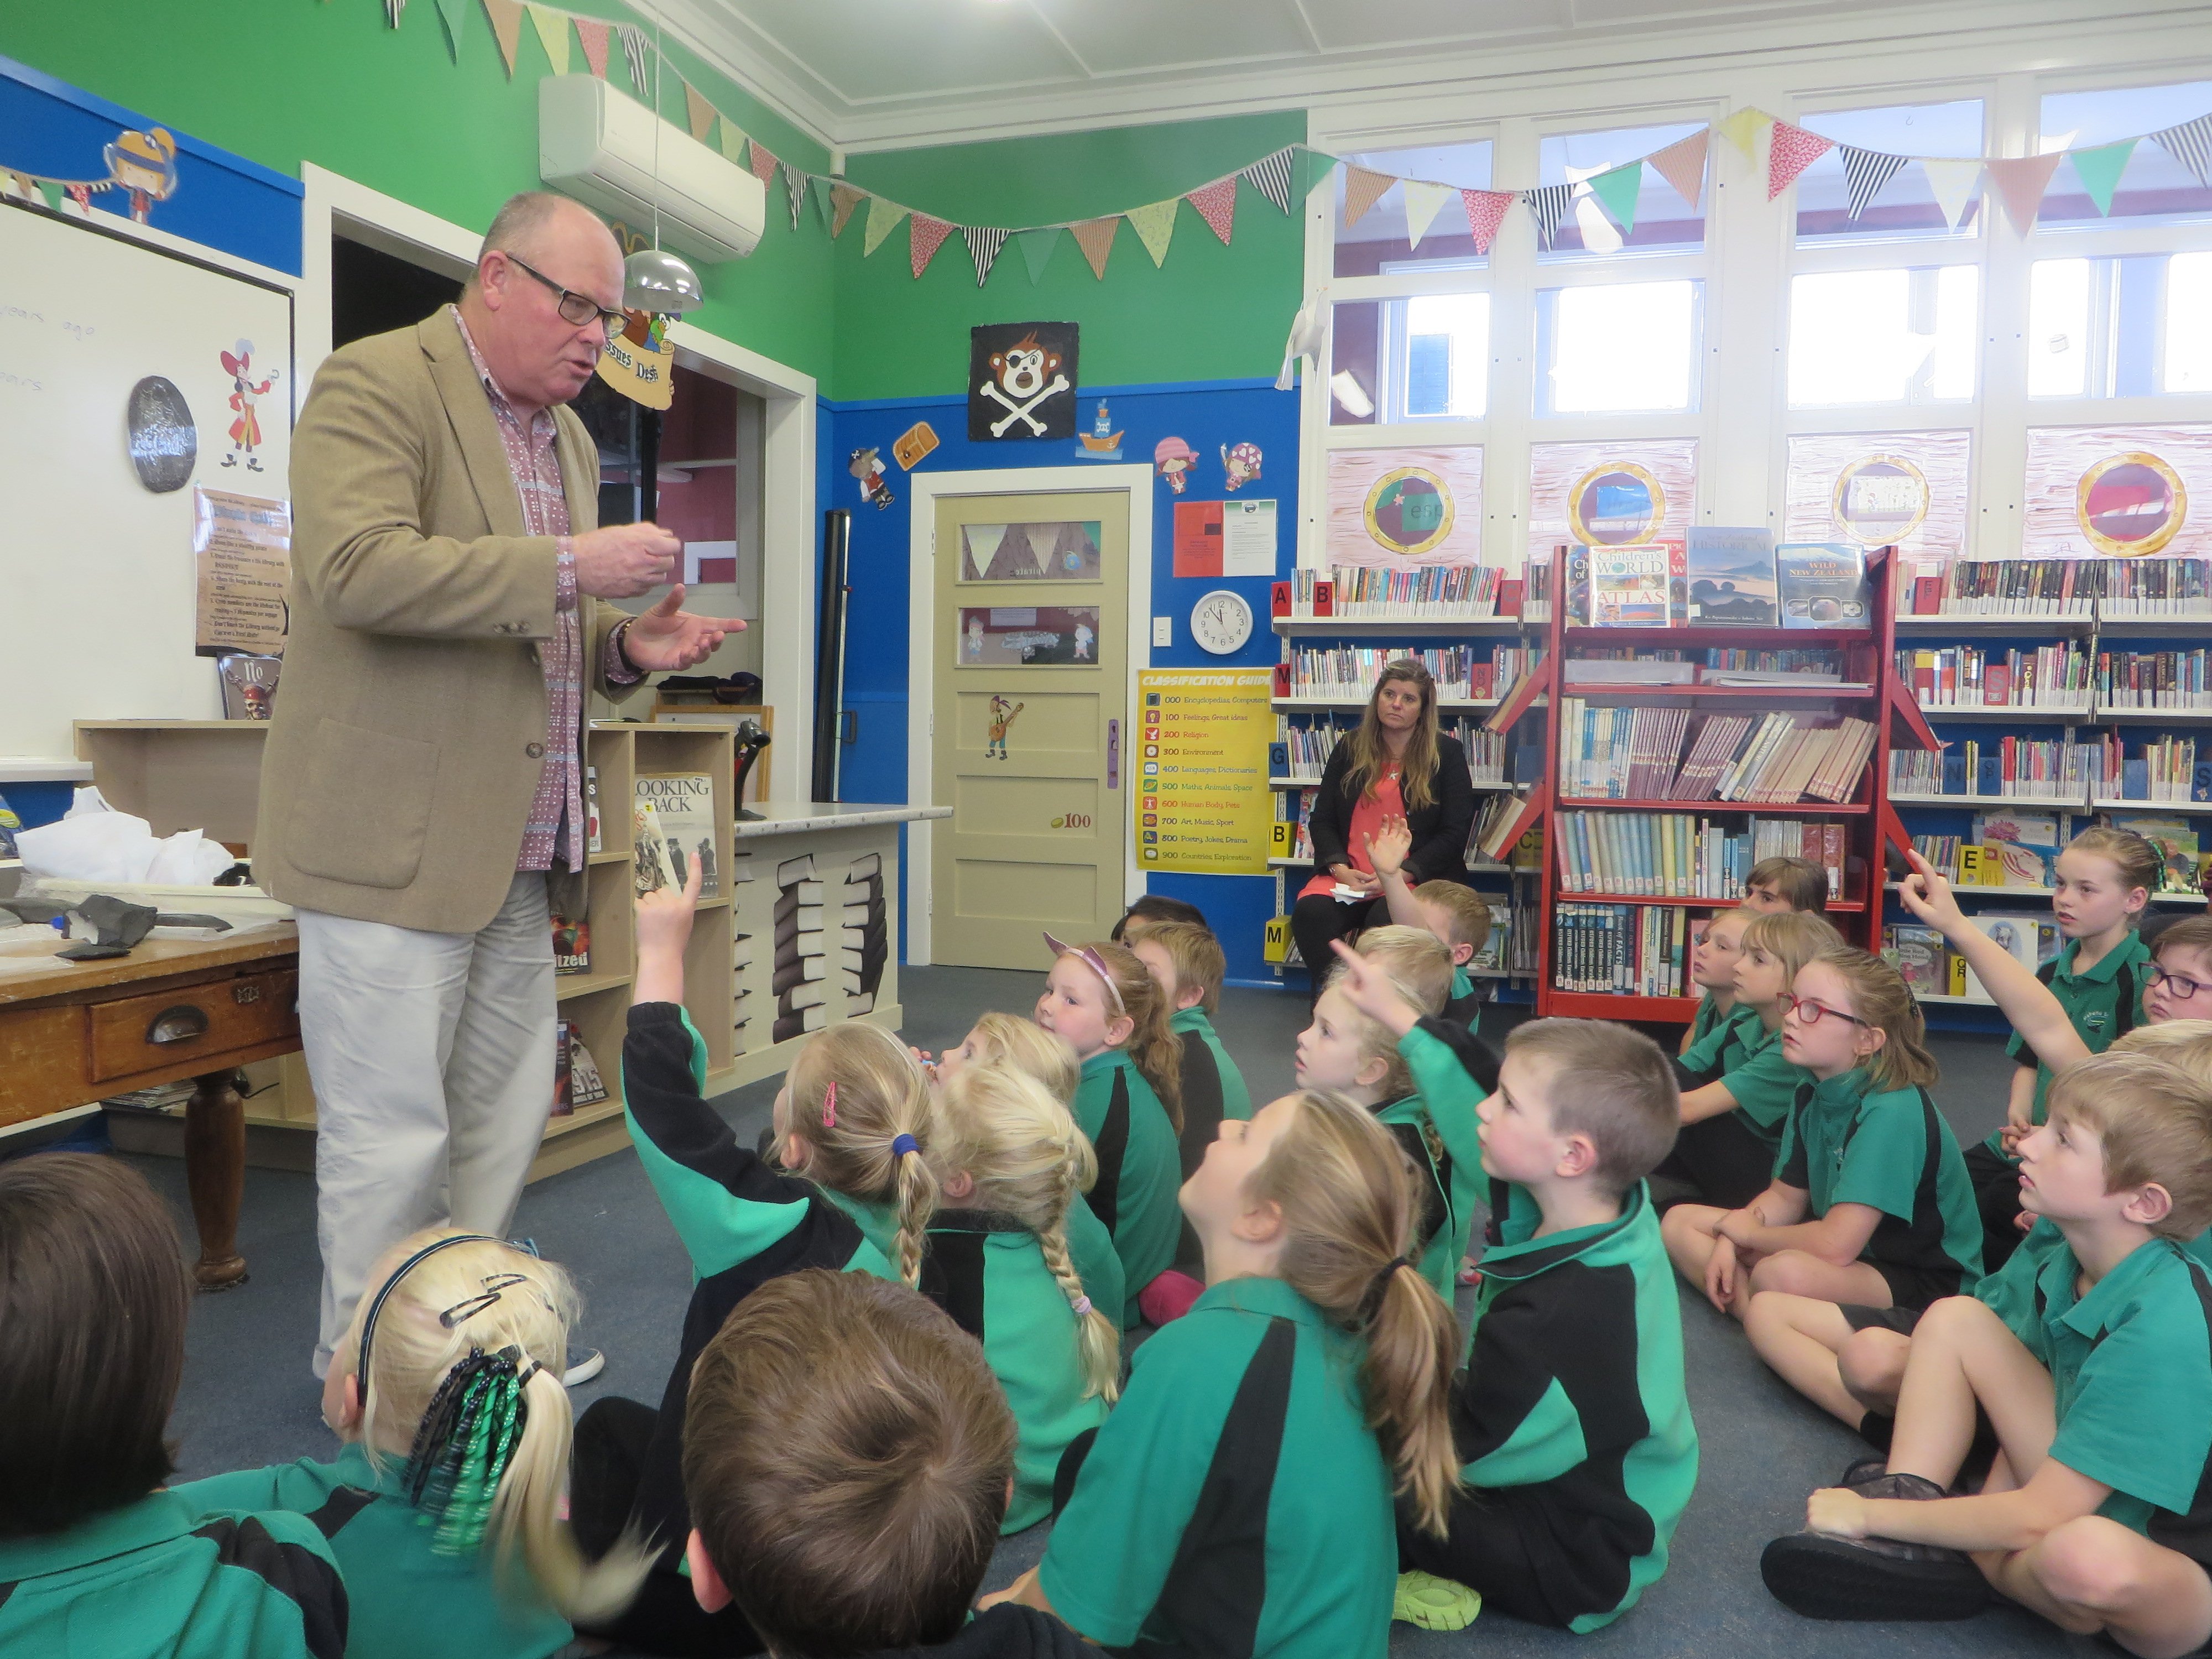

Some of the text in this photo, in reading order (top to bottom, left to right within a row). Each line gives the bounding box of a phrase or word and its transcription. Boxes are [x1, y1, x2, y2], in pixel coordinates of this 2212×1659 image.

[62, 321, 95, 341] ago
[606, 341, 659, 383] ssues Desk
[0, 371, 43, 390] ears
[1598, 552, 1661, 561] Children's
[1575, 570, 1585, 579] of
[1597, 561, 1664, 574] WORLD
[1275, 587, 1287, 604] A
[1317, 586, 1328, 603] B
[1503, 585, 1517, 602] C
[1599, 591, 1666, 604] ATLAS
[244, 660, 263, 682] No
[1278, 666, 1290, 684] M
[1142, 675, 1235, 686] CLASSIFICATION
[1990, 670, 2004, 690] S
[1272, 747, 1284, 765] G
[2197, 766, 2211, 787] S
[588, 784, 596, 795] S
[648, 796, 693, 813] BACK
[1064, 812, 1091, 828] 100
[1217, 818, 1234, 827] Sport
[1273, 826, 1285, 842] B
[1214, 854, 1251, 862] Exploration
[1964, 851, 1978, 869] E
[1267, 926, 1282, 943] M
[1616, 930, 1623, 940] of
[554, 952, 588, 968] itzed
[572, 1067, 604, 1095] 915
